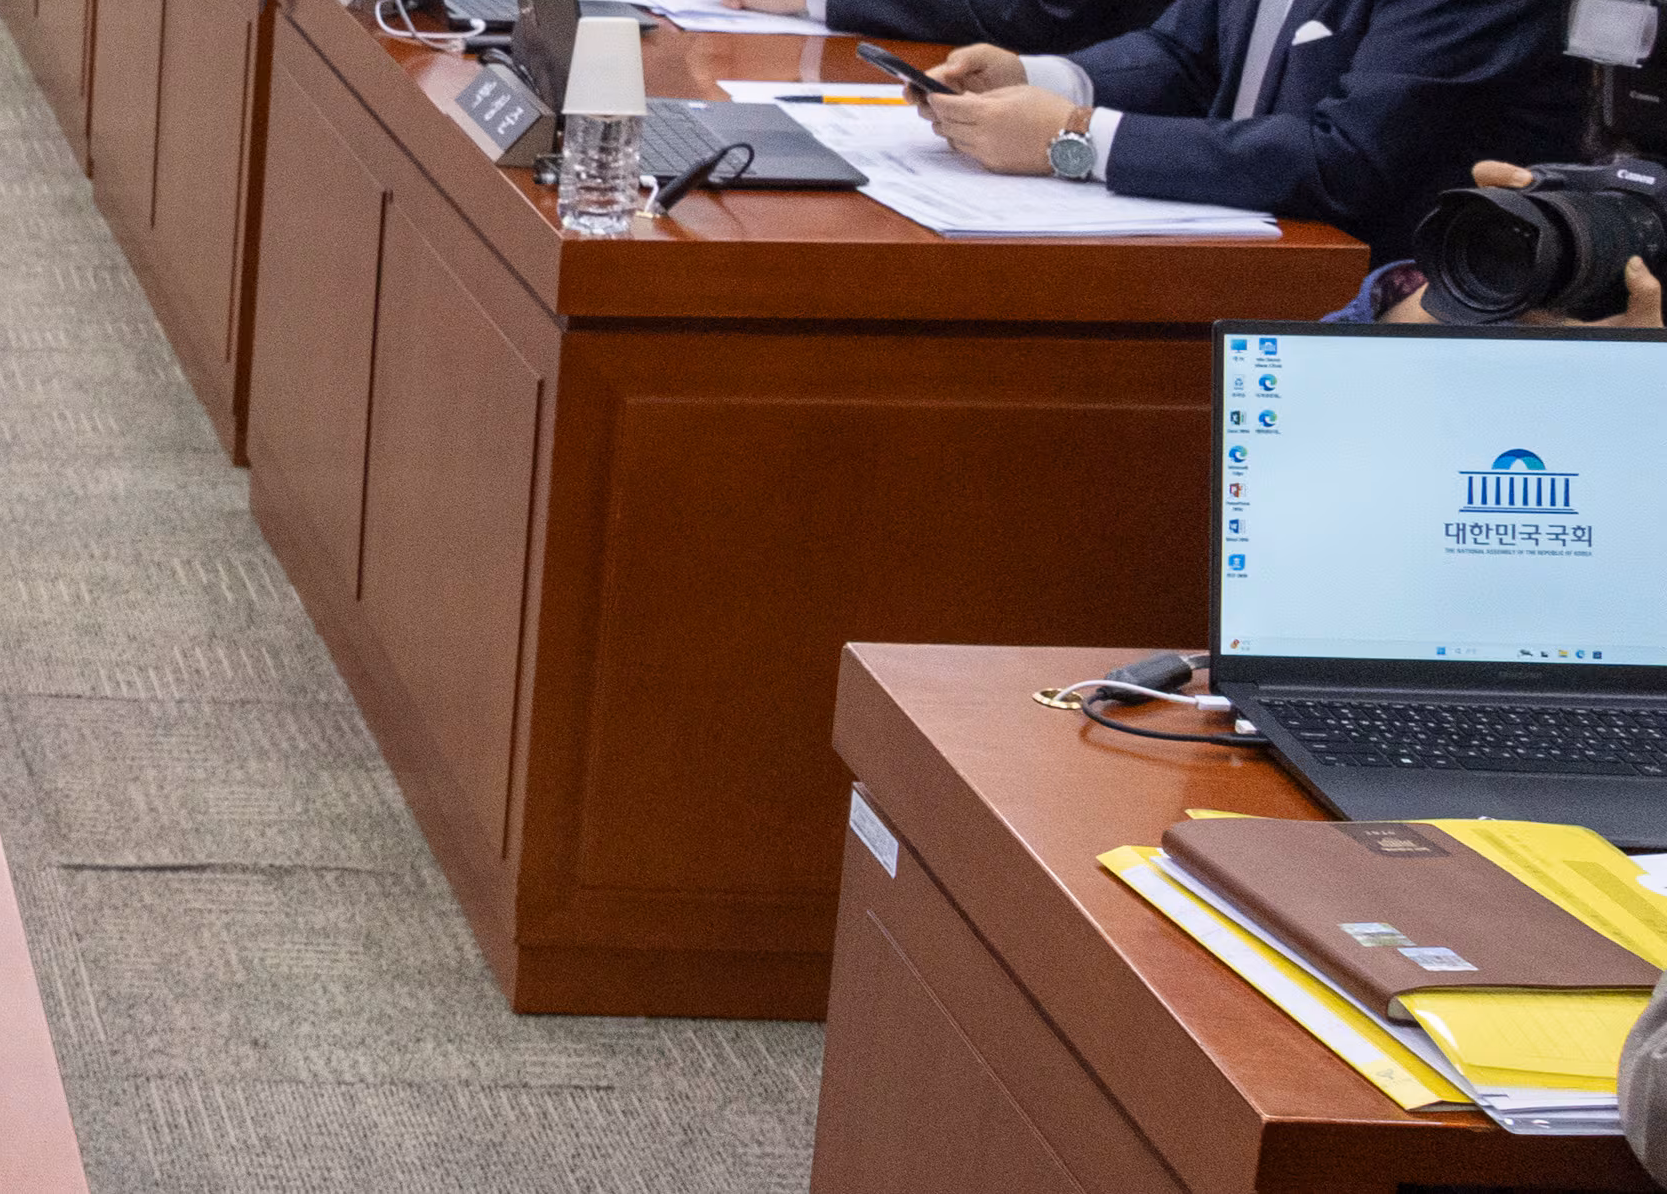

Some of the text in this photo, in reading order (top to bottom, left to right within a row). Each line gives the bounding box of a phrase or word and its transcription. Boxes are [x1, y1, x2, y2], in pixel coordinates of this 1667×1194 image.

[1616, 168, 1656, 186] Canon
[1443, 522, 1593, 548] 대한민국 국회
